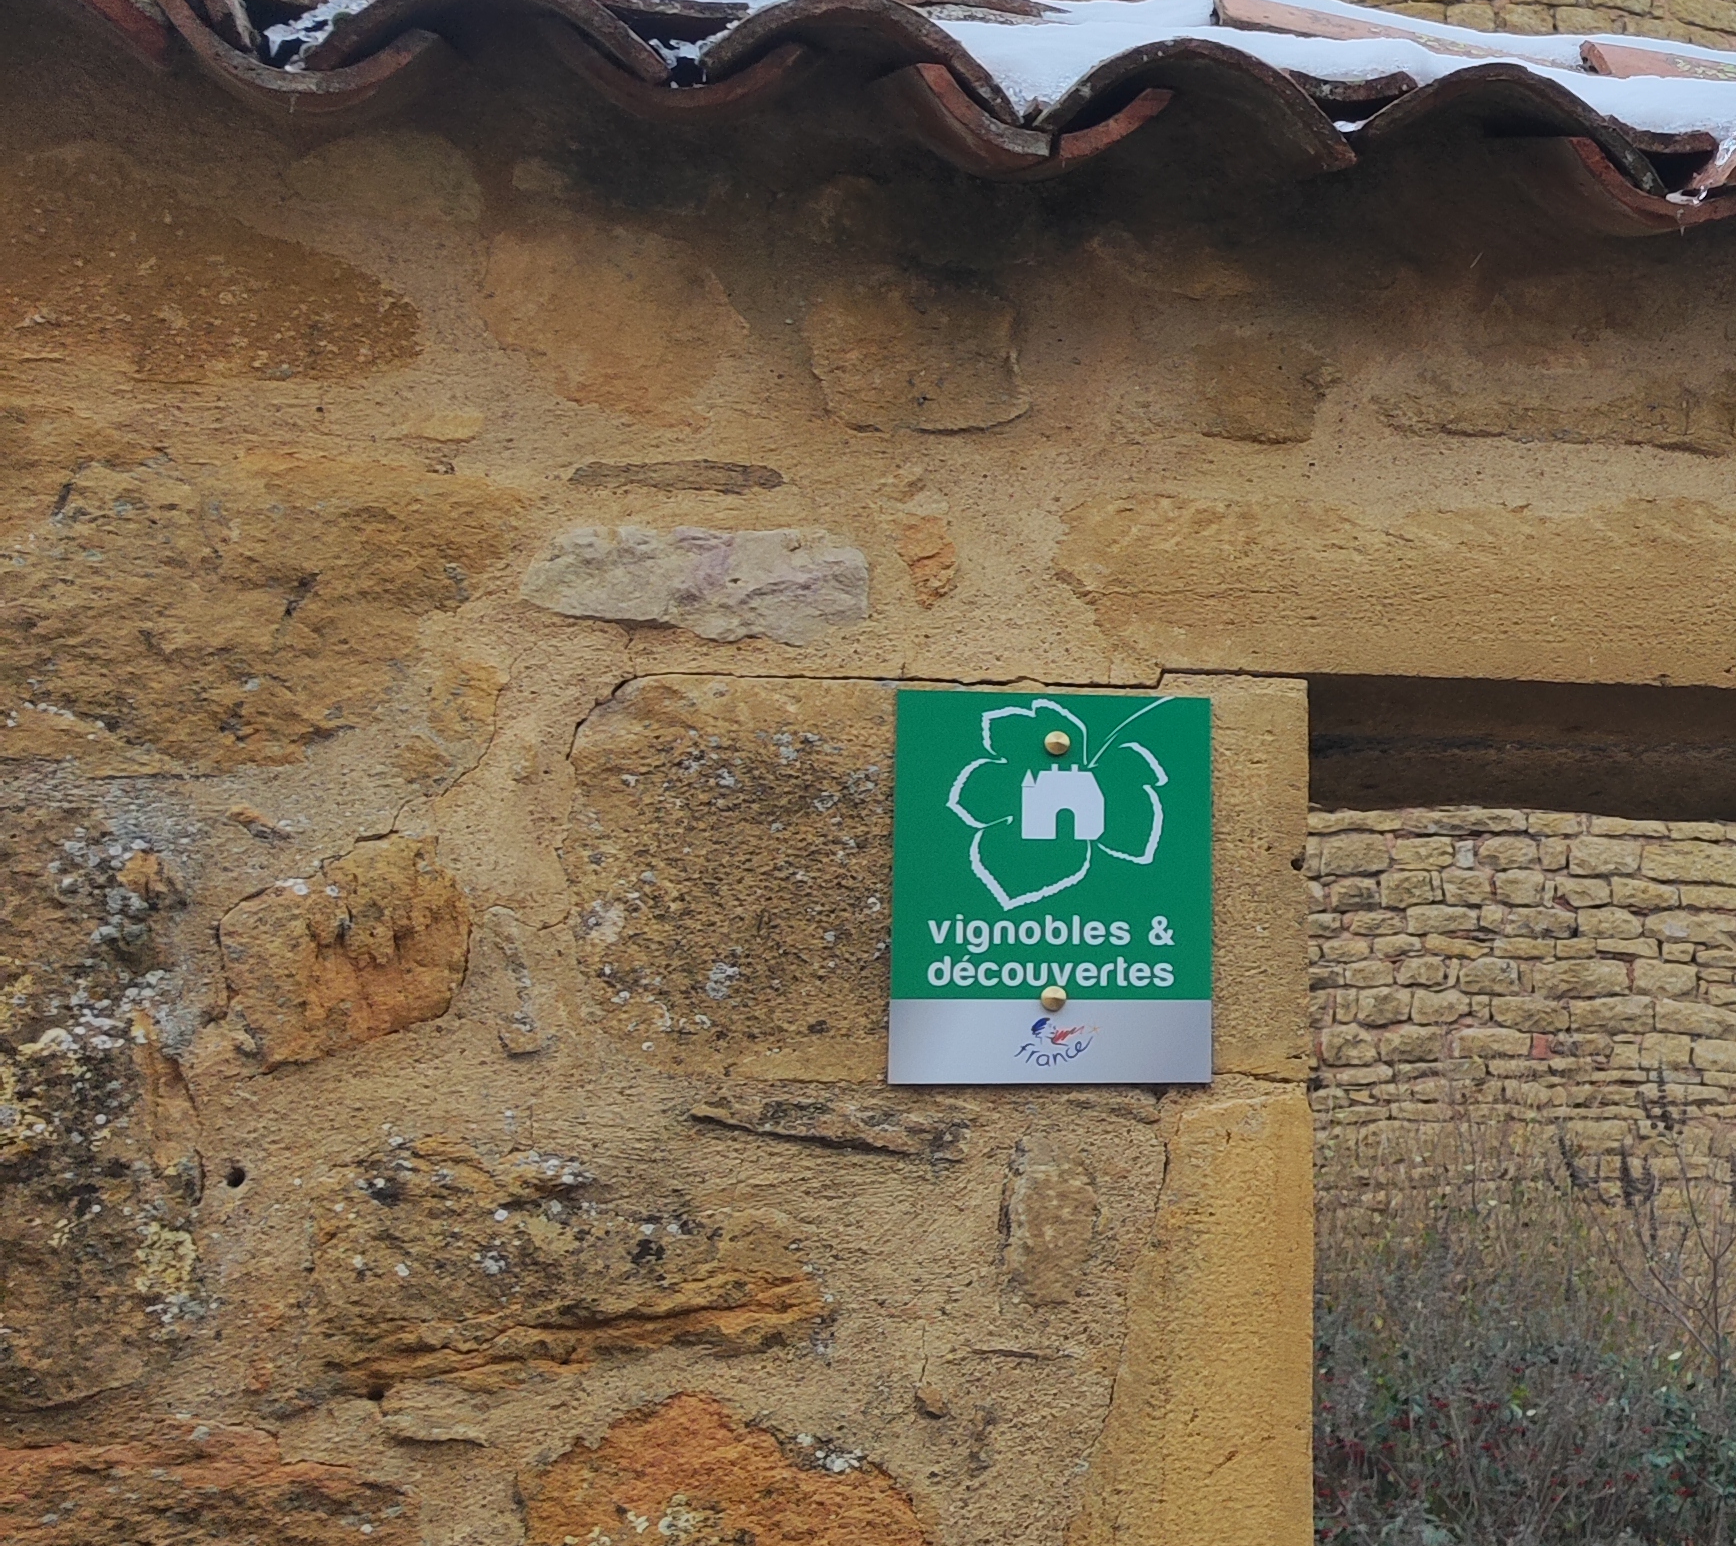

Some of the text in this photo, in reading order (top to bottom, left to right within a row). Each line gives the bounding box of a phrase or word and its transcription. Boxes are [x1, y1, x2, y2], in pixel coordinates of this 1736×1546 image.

[928, 913, 1176, 954] vignobles &
[927, 954, 1175, 987] découvertes
[1013, 1036, 1094, 1068] france
